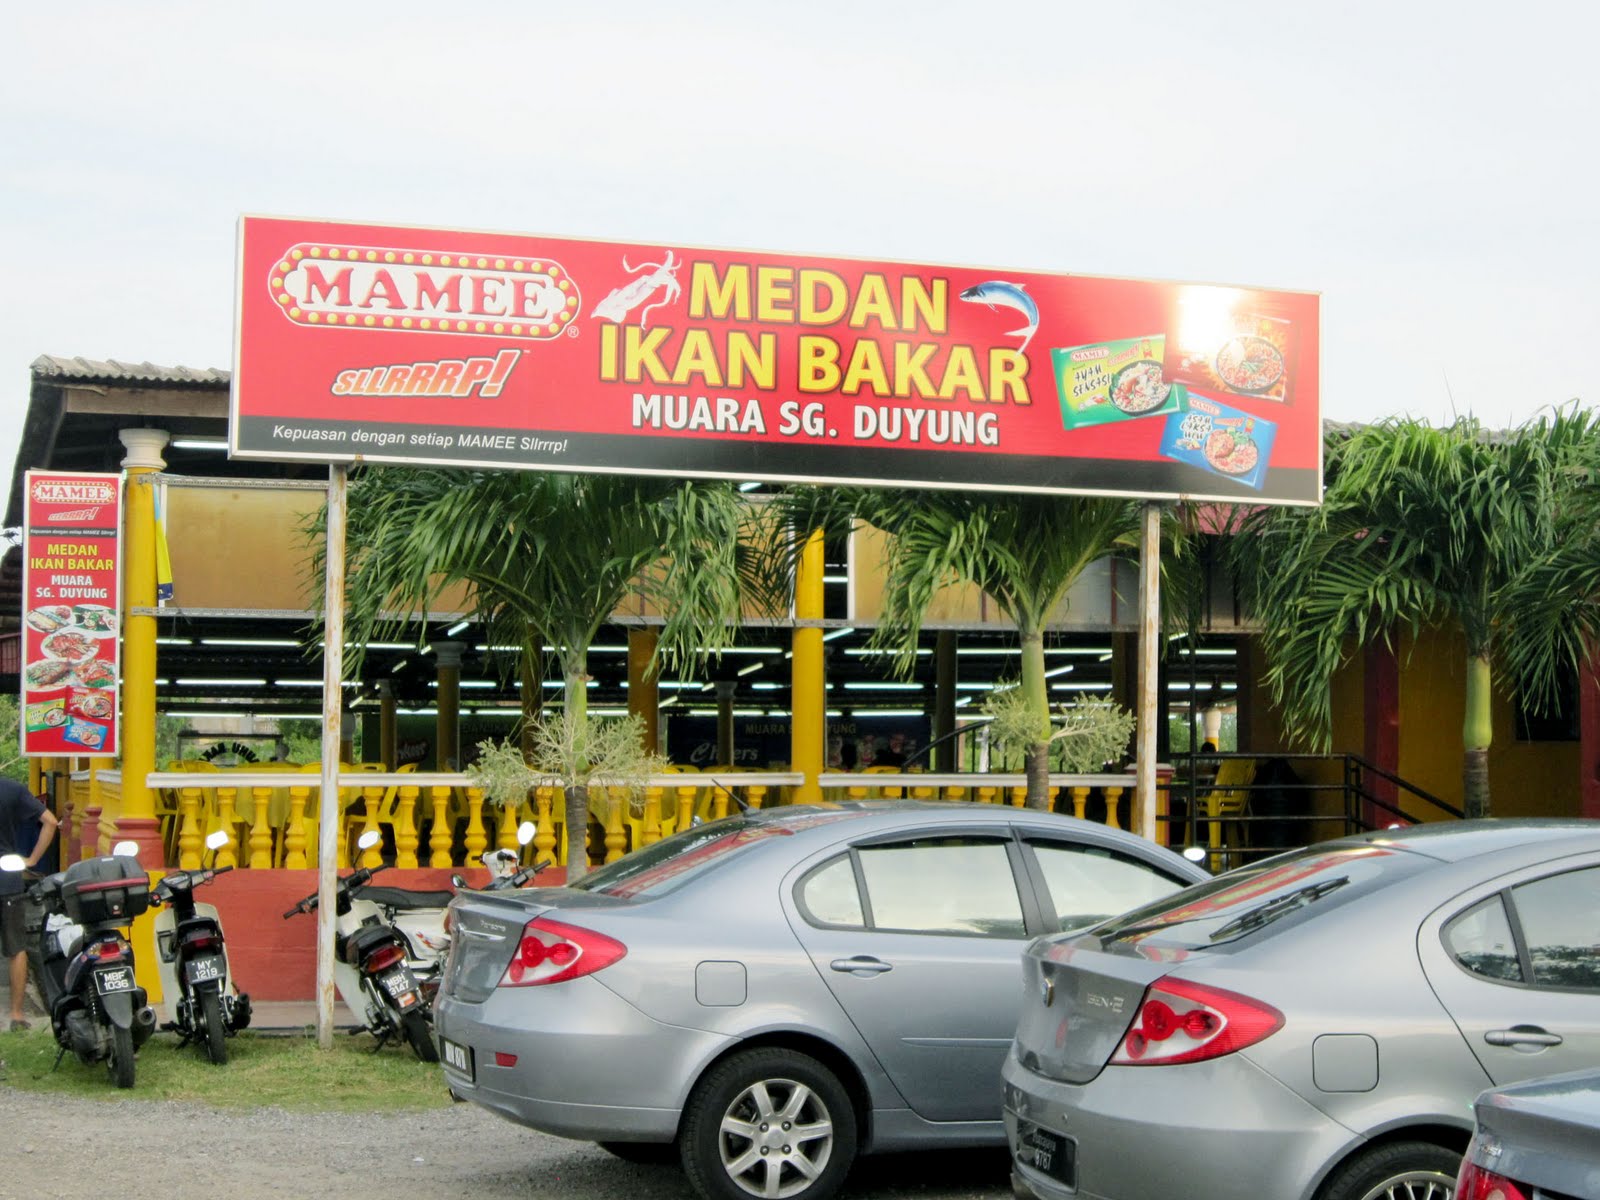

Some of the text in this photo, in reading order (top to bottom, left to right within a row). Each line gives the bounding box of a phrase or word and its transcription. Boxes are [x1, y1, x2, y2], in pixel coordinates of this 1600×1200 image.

[303, 264, 550, 320] MAMEE
[689, 260, 948, 334] MEDAN
[599, 324, 1032, 405] IKAN BAKAR
[631, 393, 1000, 447] MUARA SG. DUYUNG
[273, 425, 568, 454] Kepuasan dengan setiap MAMEE Sllrrrp!
[40, 486, 107, 499] MAMEE
[47, 544, 98, 556] MEDAN
[31, 558, 114, 571] IKAN BAKAR
[51, 575, 93, 585] MUARA
[36, 587, 108, 599] SG. DUYUNG
[745, 723, 785, 735] MUARA
[197, 960, 211, 970] MY
[103, 971, 125, 982] MBF
[104, 979, 128, 990] 1036
